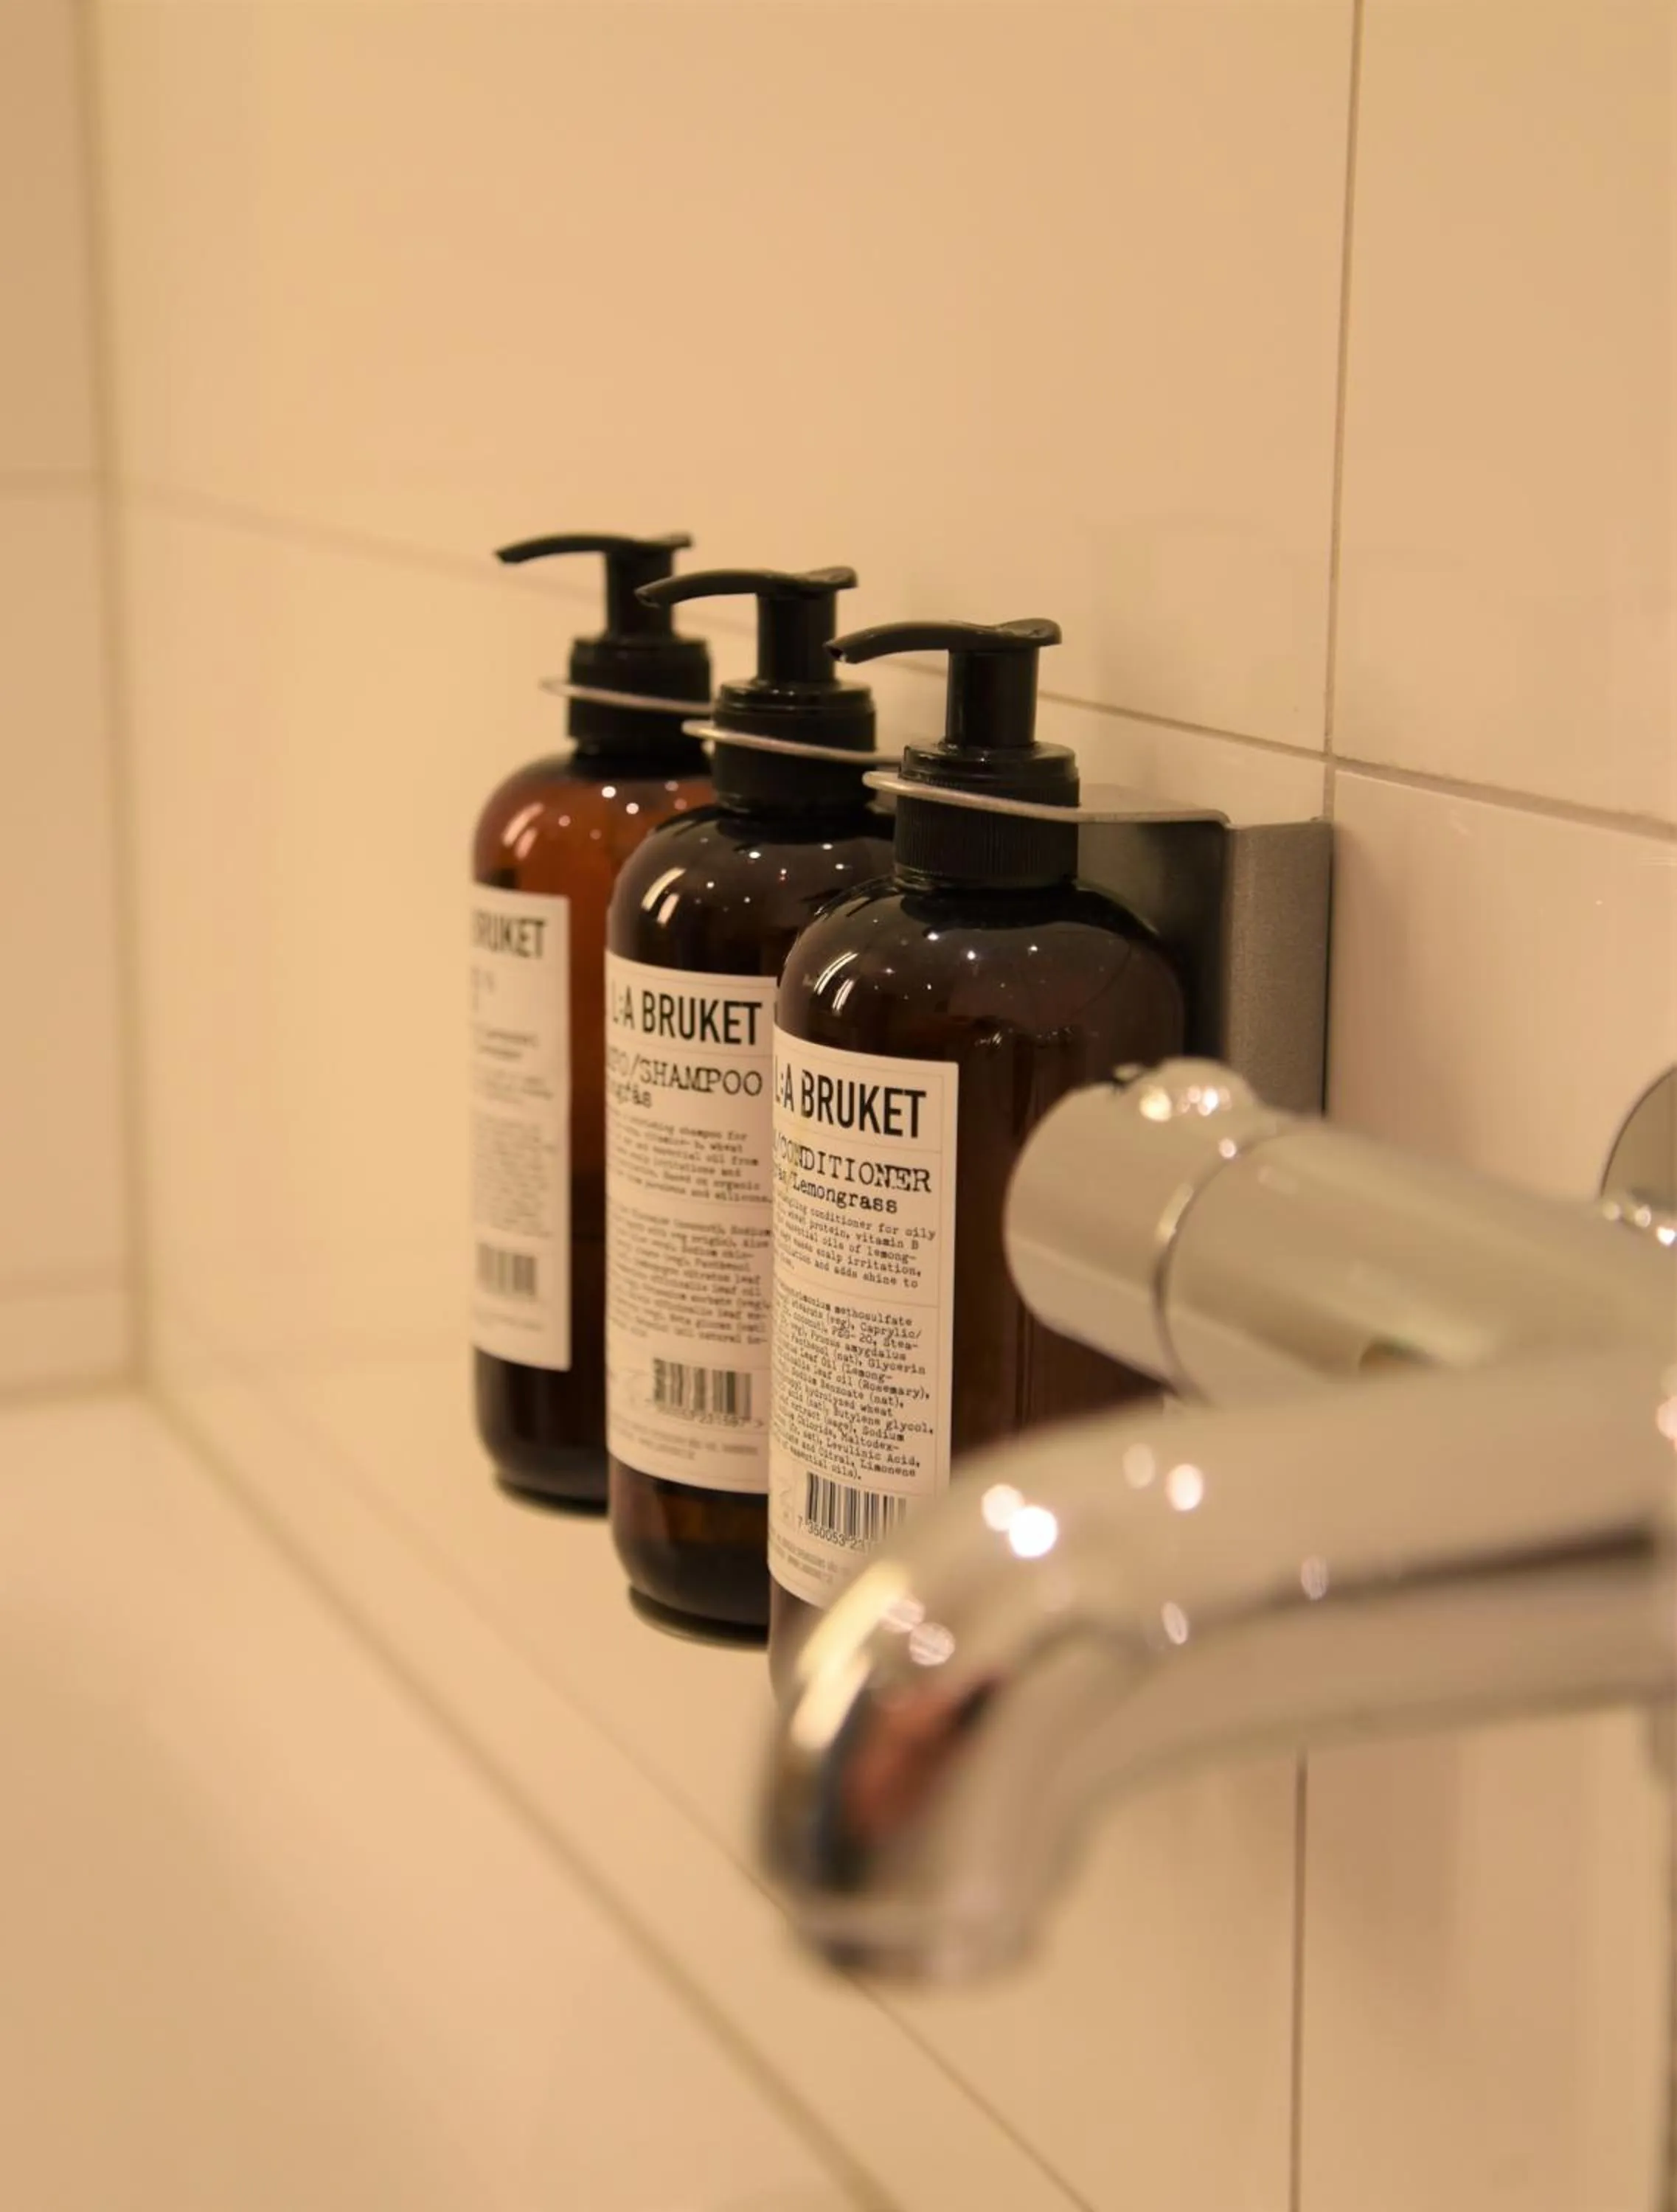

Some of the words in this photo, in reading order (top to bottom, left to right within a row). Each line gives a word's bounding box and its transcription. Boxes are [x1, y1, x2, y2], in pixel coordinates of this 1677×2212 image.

[642, 990, 763, 1046] BRUKET
[801, 1069, 926, 1138] BRUKET
[727, 1130, 747, 1141] for
[810, 1206, 872, 1230] conditioner
[878, 1222, 899, 1235] for
[905, 1227, 936, 1241] oily
[810, 1220, 850, 1239] protein,
[855, 1232, 904, 1249] vitamin
[912, 1239, 920, 1250] B
[822, 1236, 844, 1250] oils
[849, 1244, 862, 1254] of
[816, 1246, 843, 1264] scalp
[847, 1253, 922, 1278] irritation,
[814, 1259, 830, 1272] and
[833, 1264, 858, 1279] adds
[862, 1270, 897, 1287] shine
[903, 1276, 919, 1288] to
[834, 1305, 913, 1327] methosulfate
[844, 1342, 907, 1361] amygdalus
[867, 1358, 926, 1377] Glycerin
[860, 1403, 895, 1416] wheat
[862, 1425, 906, 1442] Sodium
[886, 1419, 934, 1436] glycol,
[860, 1458, 917, 1478] Limonene
[886, 1453, 921, 1469] Acid,
